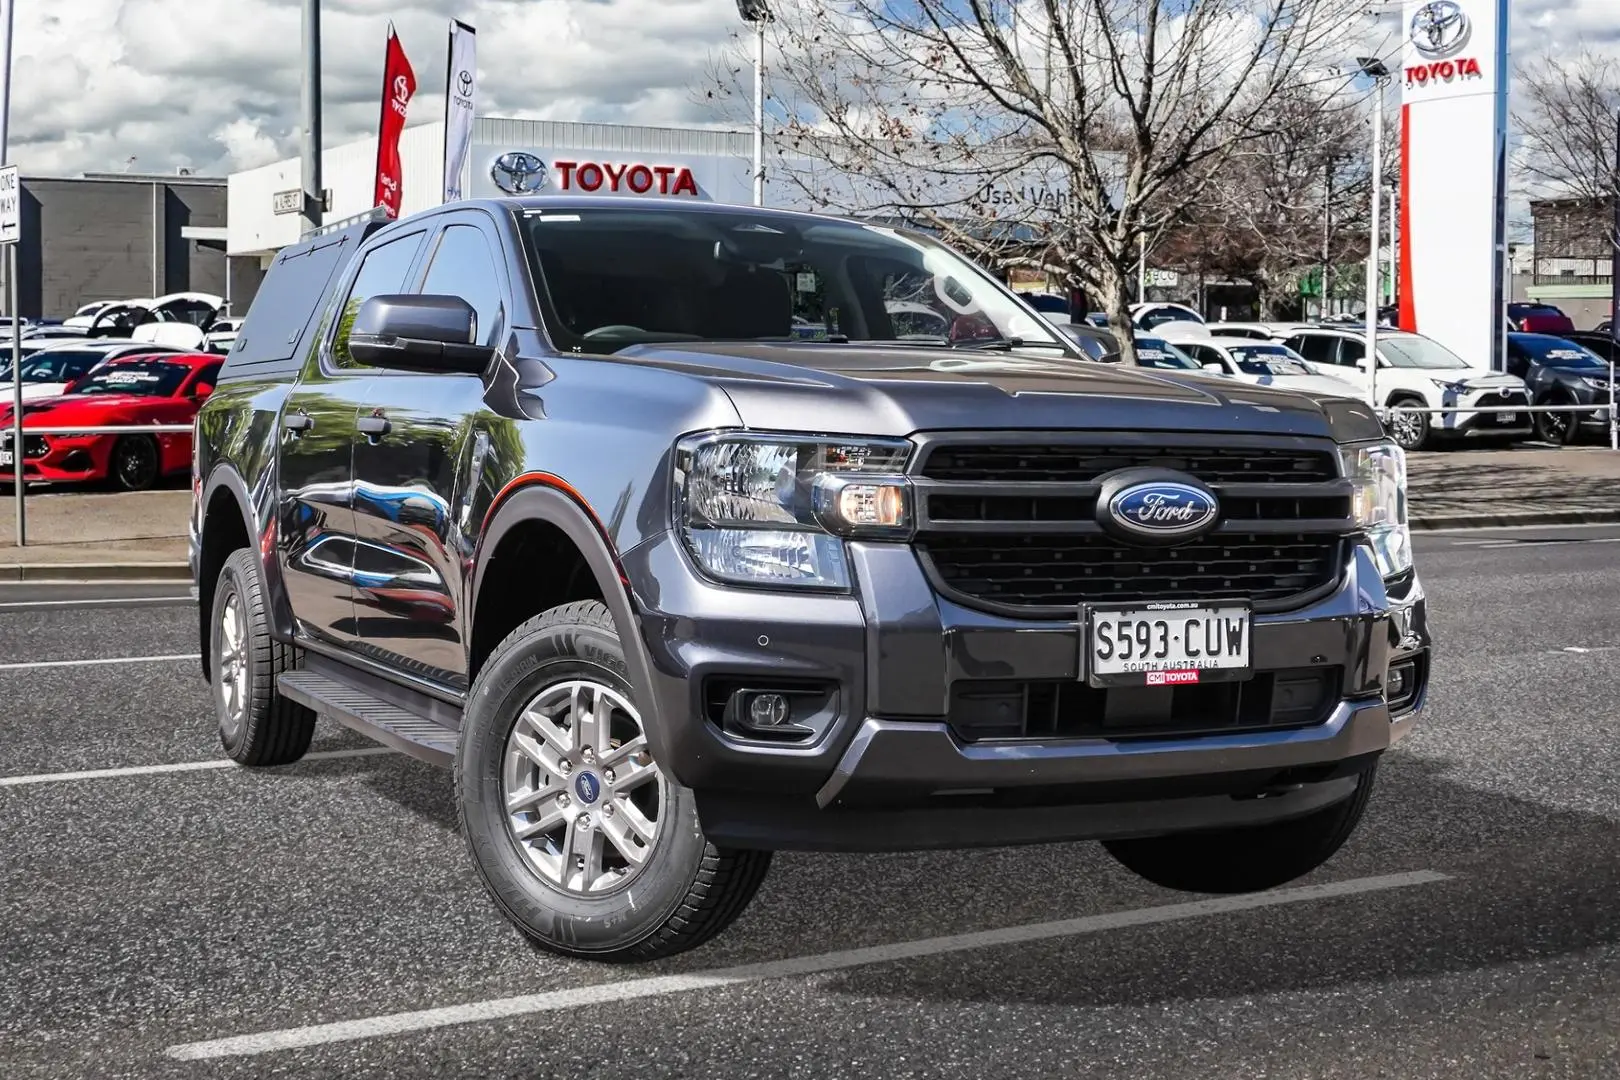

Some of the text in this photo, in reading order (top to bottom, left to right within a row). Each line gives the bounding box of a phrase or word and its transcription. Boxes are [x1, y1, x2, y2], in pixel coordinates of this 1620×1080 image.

[1404, 58, 1481, 83] TOYOTA
[1, 173, 15, 191] ONE
[554, 161, 698, 196] TOYOTA
[1, 196, 16, 214] WAY
[1138, 492, 1195, 521] Ford
[1147, 602, 1198, 610] cmitoyota.com.au
[1124, 659, 1219, 672] SOUTH AUSTRALIA
[1147, 671, 1199, 684] CMI TOYOTA
